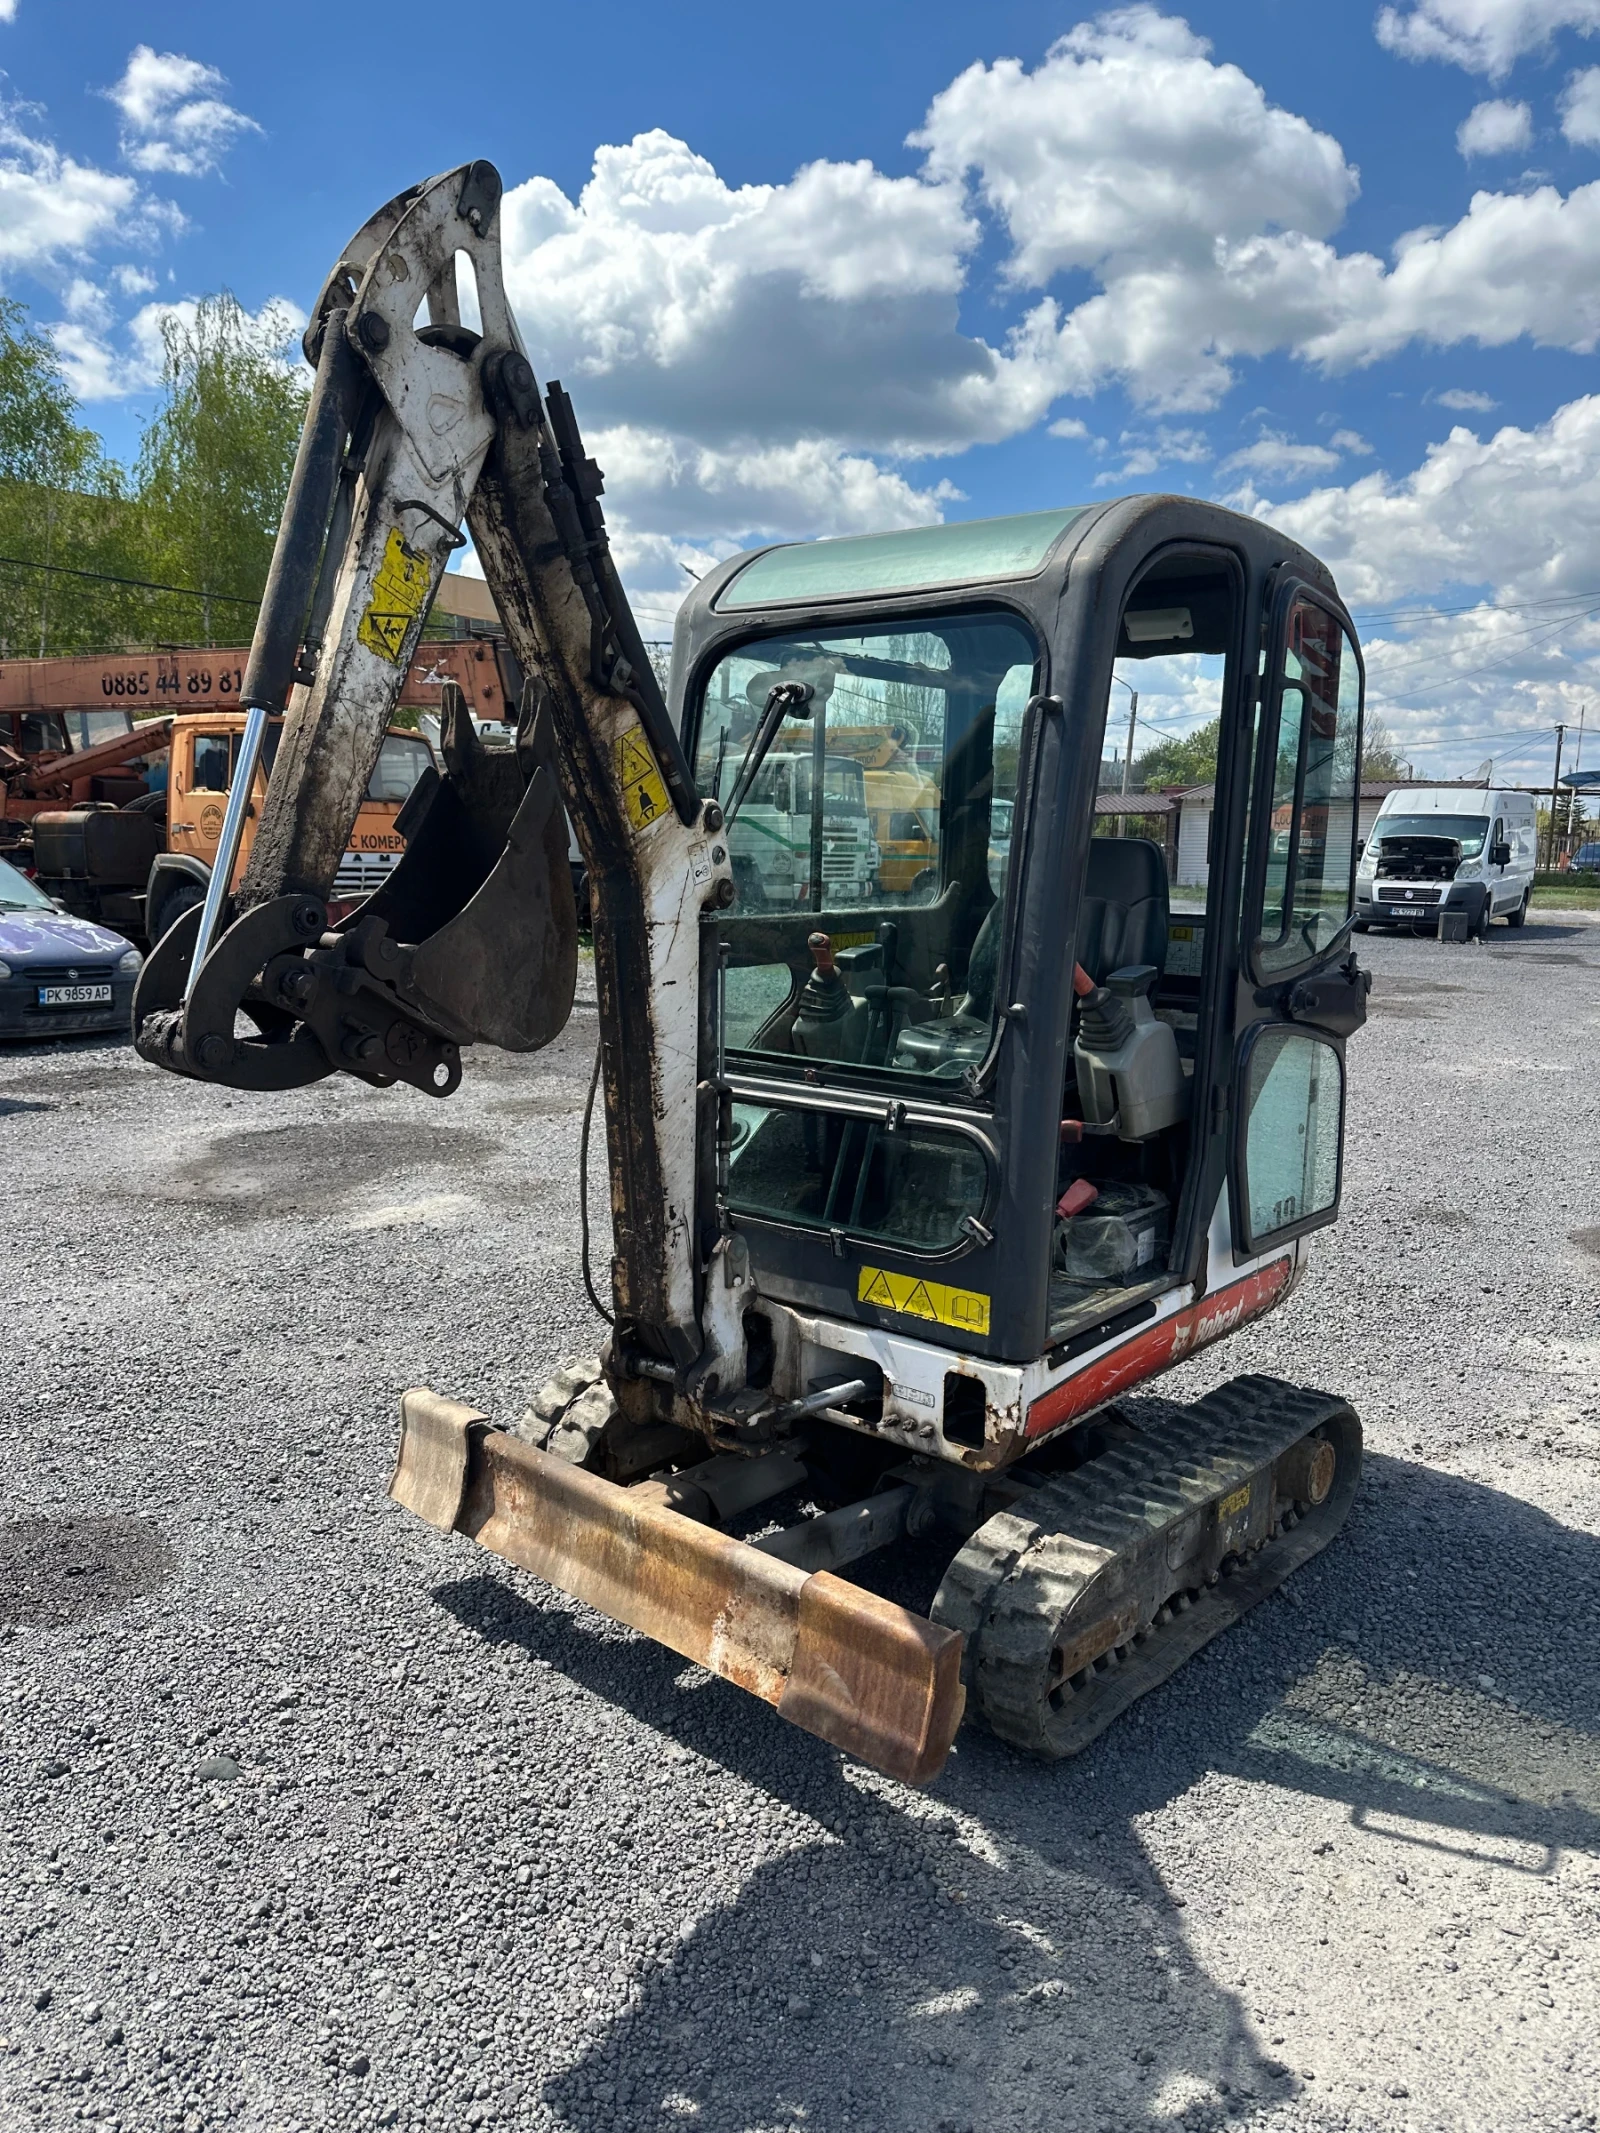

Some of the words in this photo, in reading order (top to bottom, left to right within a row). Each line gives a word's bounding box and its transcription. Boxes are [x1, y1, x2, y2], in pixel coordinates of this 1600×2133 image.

[101, 672, 150, 696] 0885
[187, 669, 212, 693] 89
[46, 989, 62, 1002] PK
[64, 987, 93, 1000] 9859
[94, 986, 109, 999] AP
